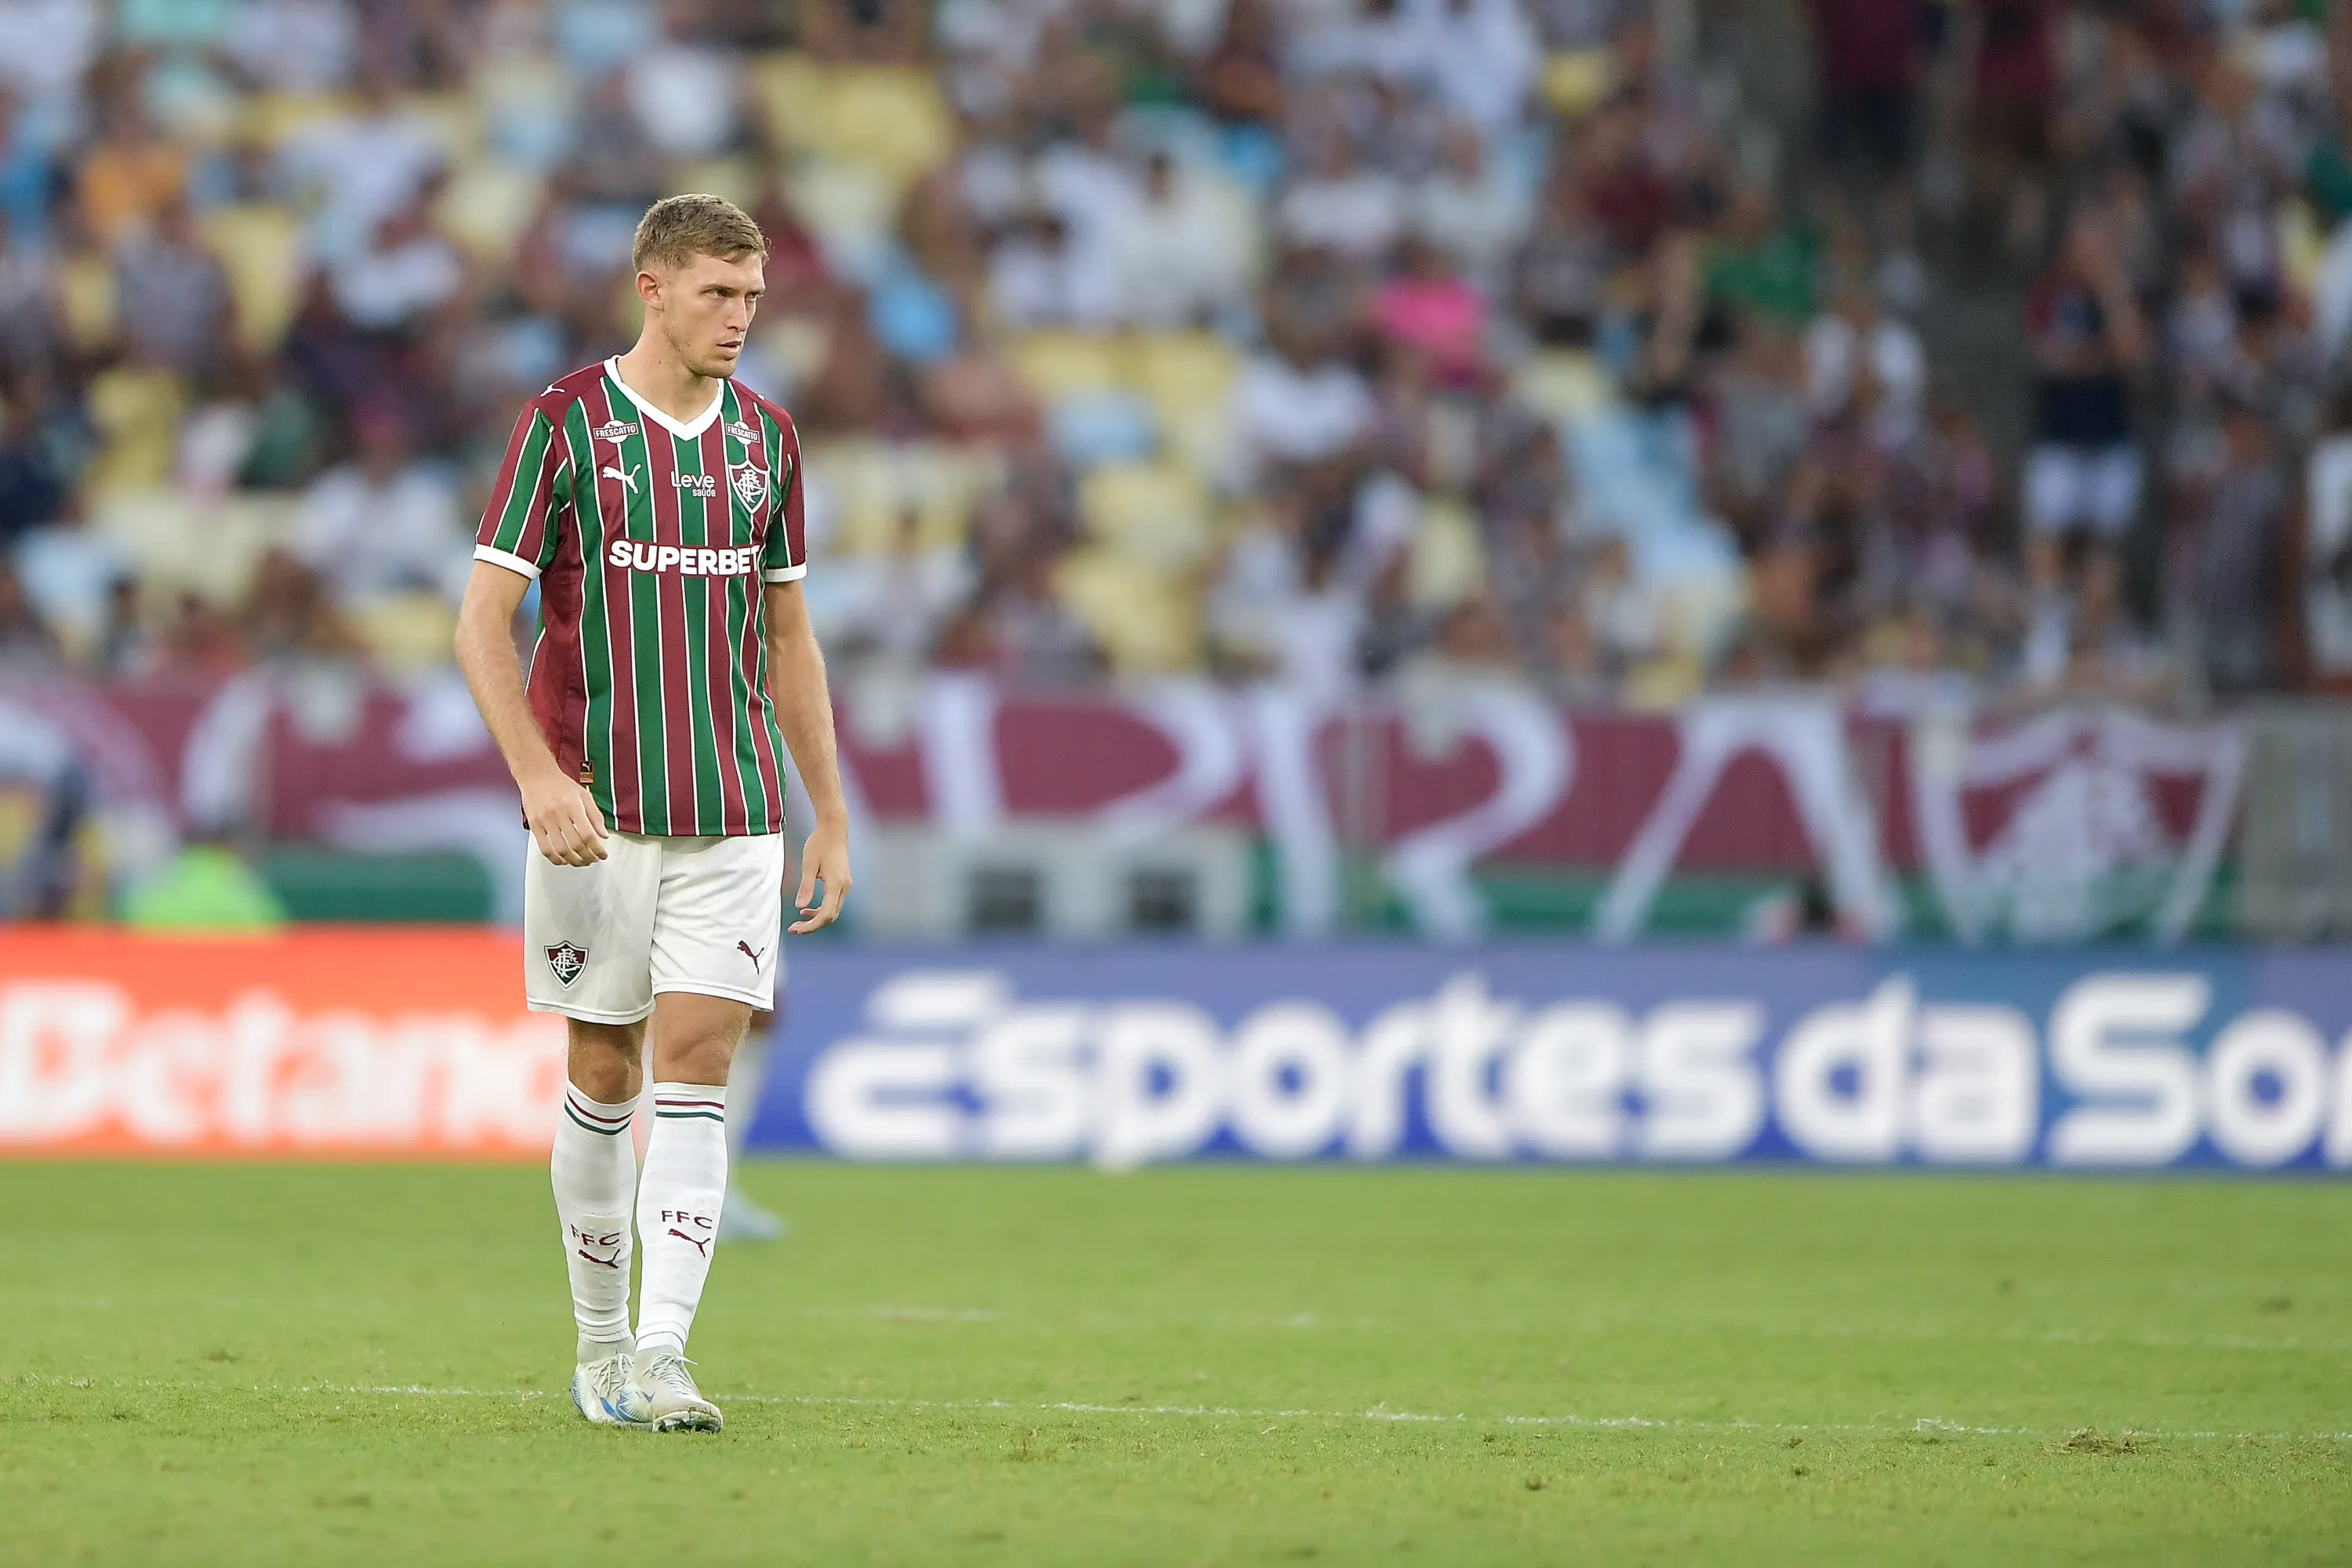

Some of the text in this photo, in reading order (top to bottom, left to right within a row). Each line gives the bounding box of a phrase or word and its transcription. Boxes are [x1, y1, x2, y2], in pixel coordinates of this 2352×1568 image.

[595, 424, 637, 438] FRESCATTO
[727, 425, 758, 441] FRESCATTO
[670, 470, 715, 488] Leve
[608, 540, 760, 575] SUPERBET
[661, 1210, 713, 1229] FFC
[571, 1223, 620, 1246] FFC
